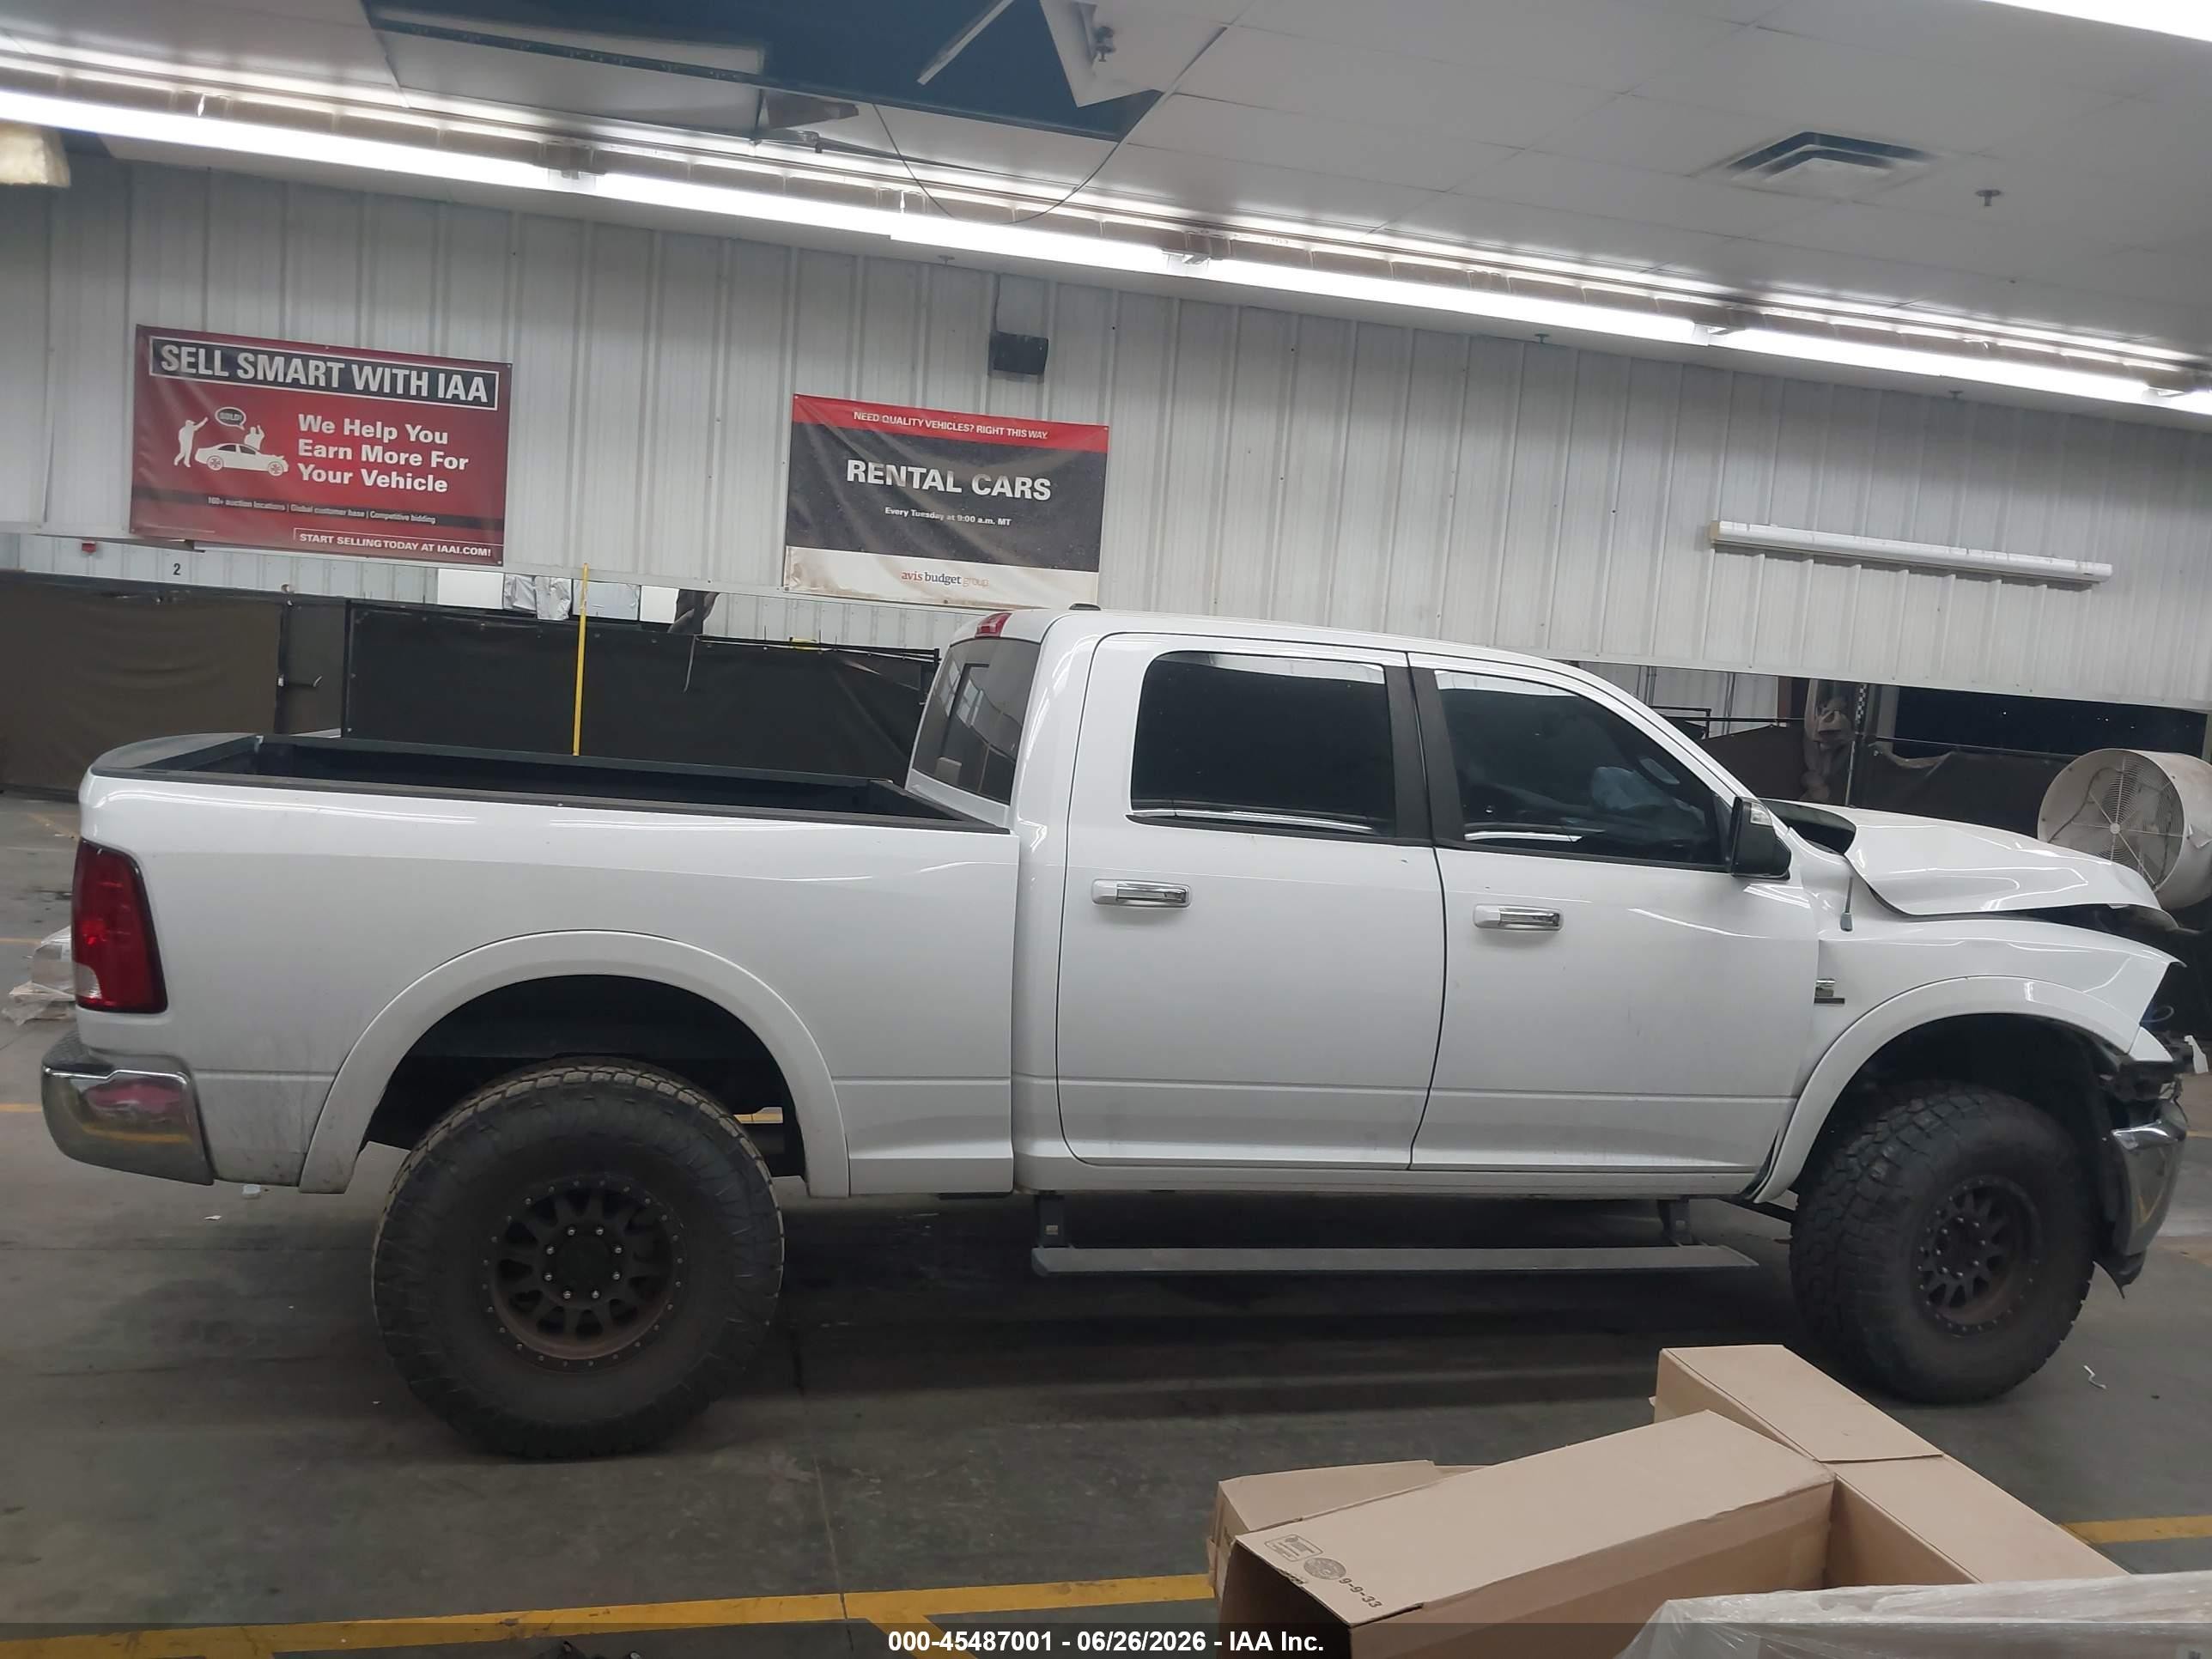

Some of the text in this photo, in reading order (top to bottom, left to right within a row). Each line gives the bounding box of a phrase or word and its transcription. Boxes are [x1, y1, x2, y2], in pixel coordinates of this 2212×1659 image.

[161, 344, 488, 402] SELL SMART WITH IAA
[299, 414, 448, 445] We Help You
[854, 411, 879, 422] NEED
[882, 414, 924, 427] QUALITY
[925, 419, 975, 432] VEHICLES?
[976, 425, 1005, 435] RIGHT
[1006, 428, 1026, 438] THIS
[299, 440, 468, 471] Earn More For
[298, 464, 447, 492] Your Vehicle
[847, 459, 1051, 501] RENTAL CARS
[370, 511, 410, 521] Competitive
[410, 514, 435, 525] bidding
[885, 507, 908, 518] Every
[910, 509, 944, 520] Tuesday
[957, 514, 975, 523] 9:00
[300, 533, 491, 556] START SELLING TODAY AT IAAI.COM!
[173, 563, 180, 575] 2
[902, 571, 988, 587] avis budget group
[1340, 1578, 1382, 1608] 9-9-33
